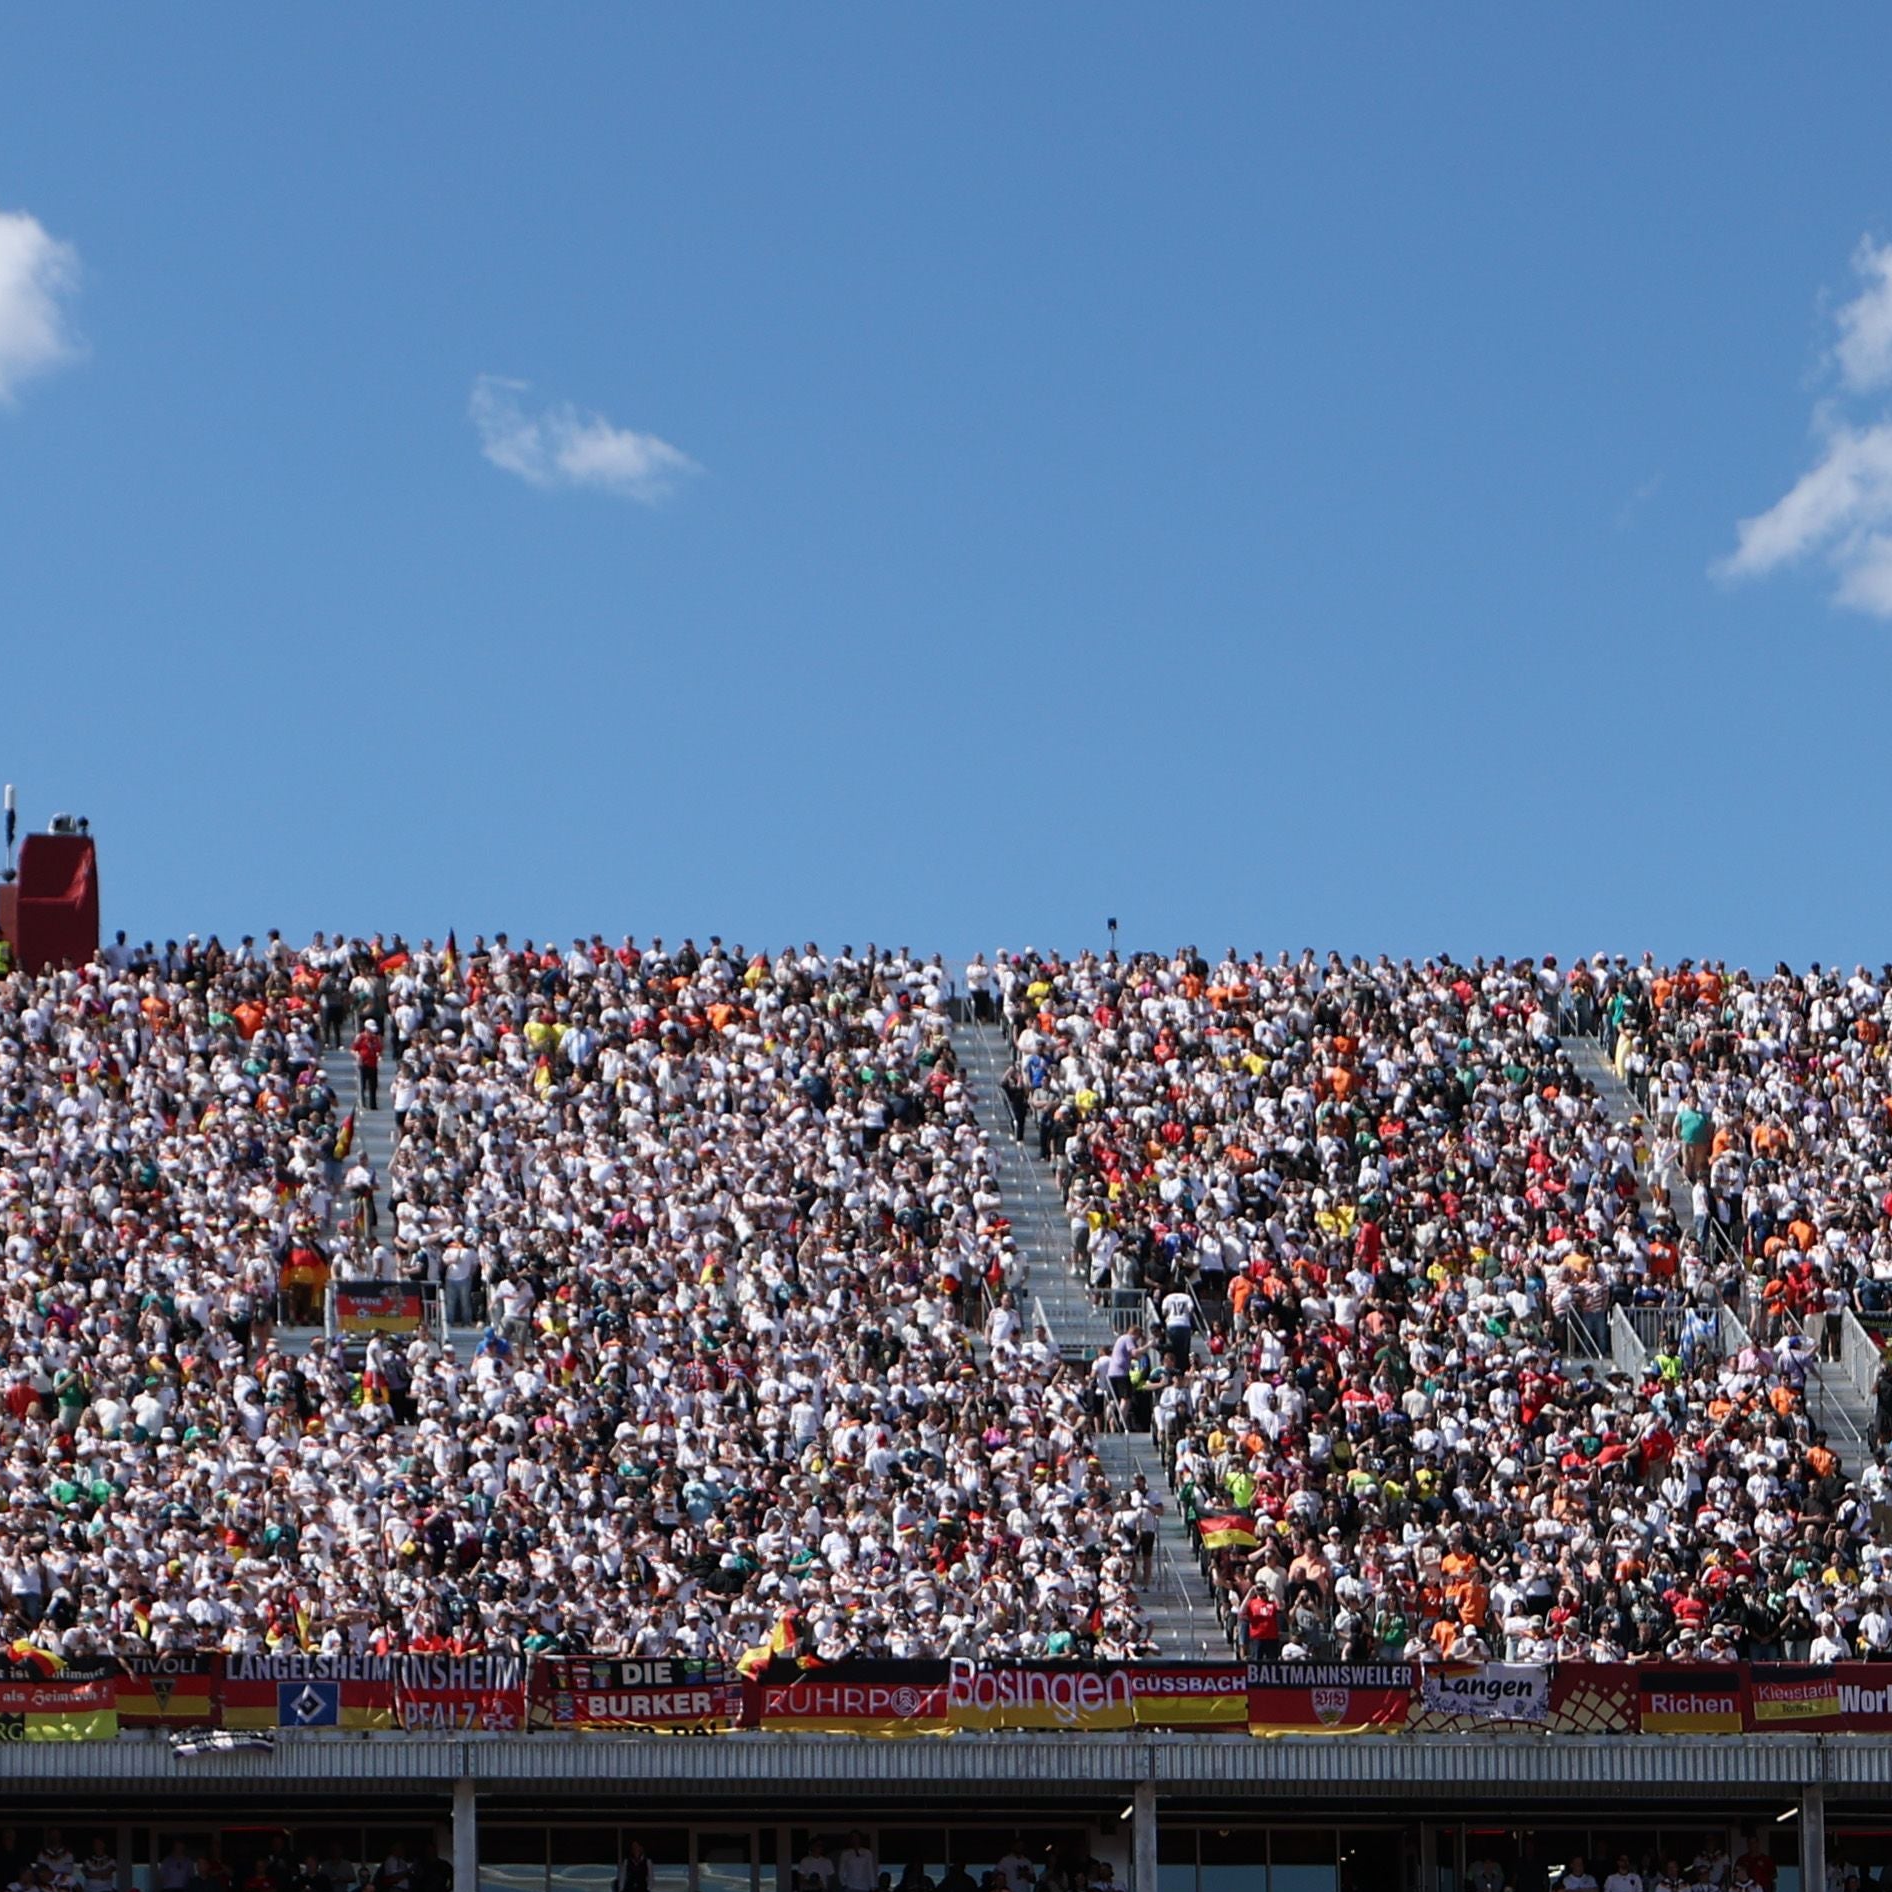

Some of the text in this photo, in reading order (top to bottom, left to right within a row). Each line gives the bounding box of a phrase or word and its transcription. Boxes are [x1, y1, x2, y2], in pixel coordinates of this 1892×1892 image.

[129, 1656, 198, 1674] TIVOLI
[621, 1662, 673, 1686] DIE
[1246, 1663, 1413, 1687] BALTMANNSWEILER
[1131, 1672, 1248, 1693] GÜSSBACH
[1439, 1674, 1534, 1704] Langen
[588, 1691, 710, 1718] BURKER
[1651, 1693, 1735, 1714] Richen
